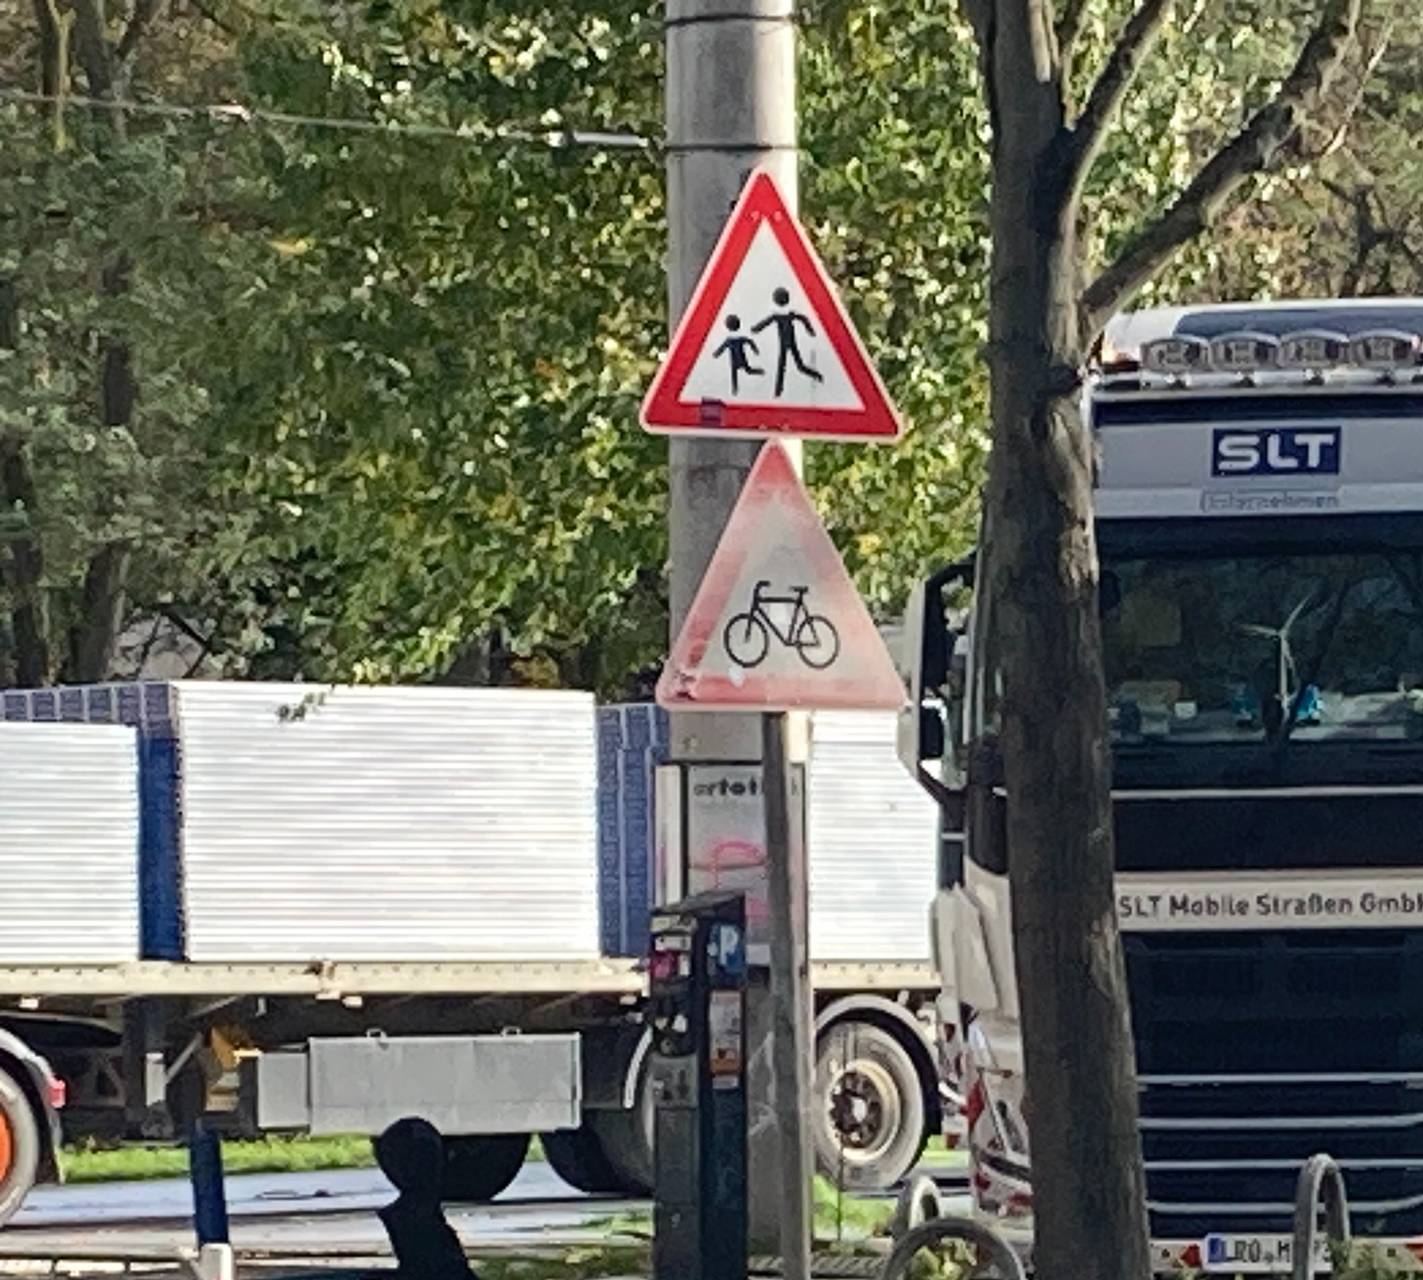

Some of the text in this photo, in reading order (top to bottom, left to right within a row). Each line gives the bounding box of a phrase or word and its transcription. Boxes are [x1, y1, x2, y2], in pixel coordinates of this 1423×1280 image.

[1217, 433, 1336, 470] SLT
[1119, 895, 1162, 918] SLT
[1169, 893, 1249, 917] Mobile
[1256, 893, 1353, 916] Straßen
